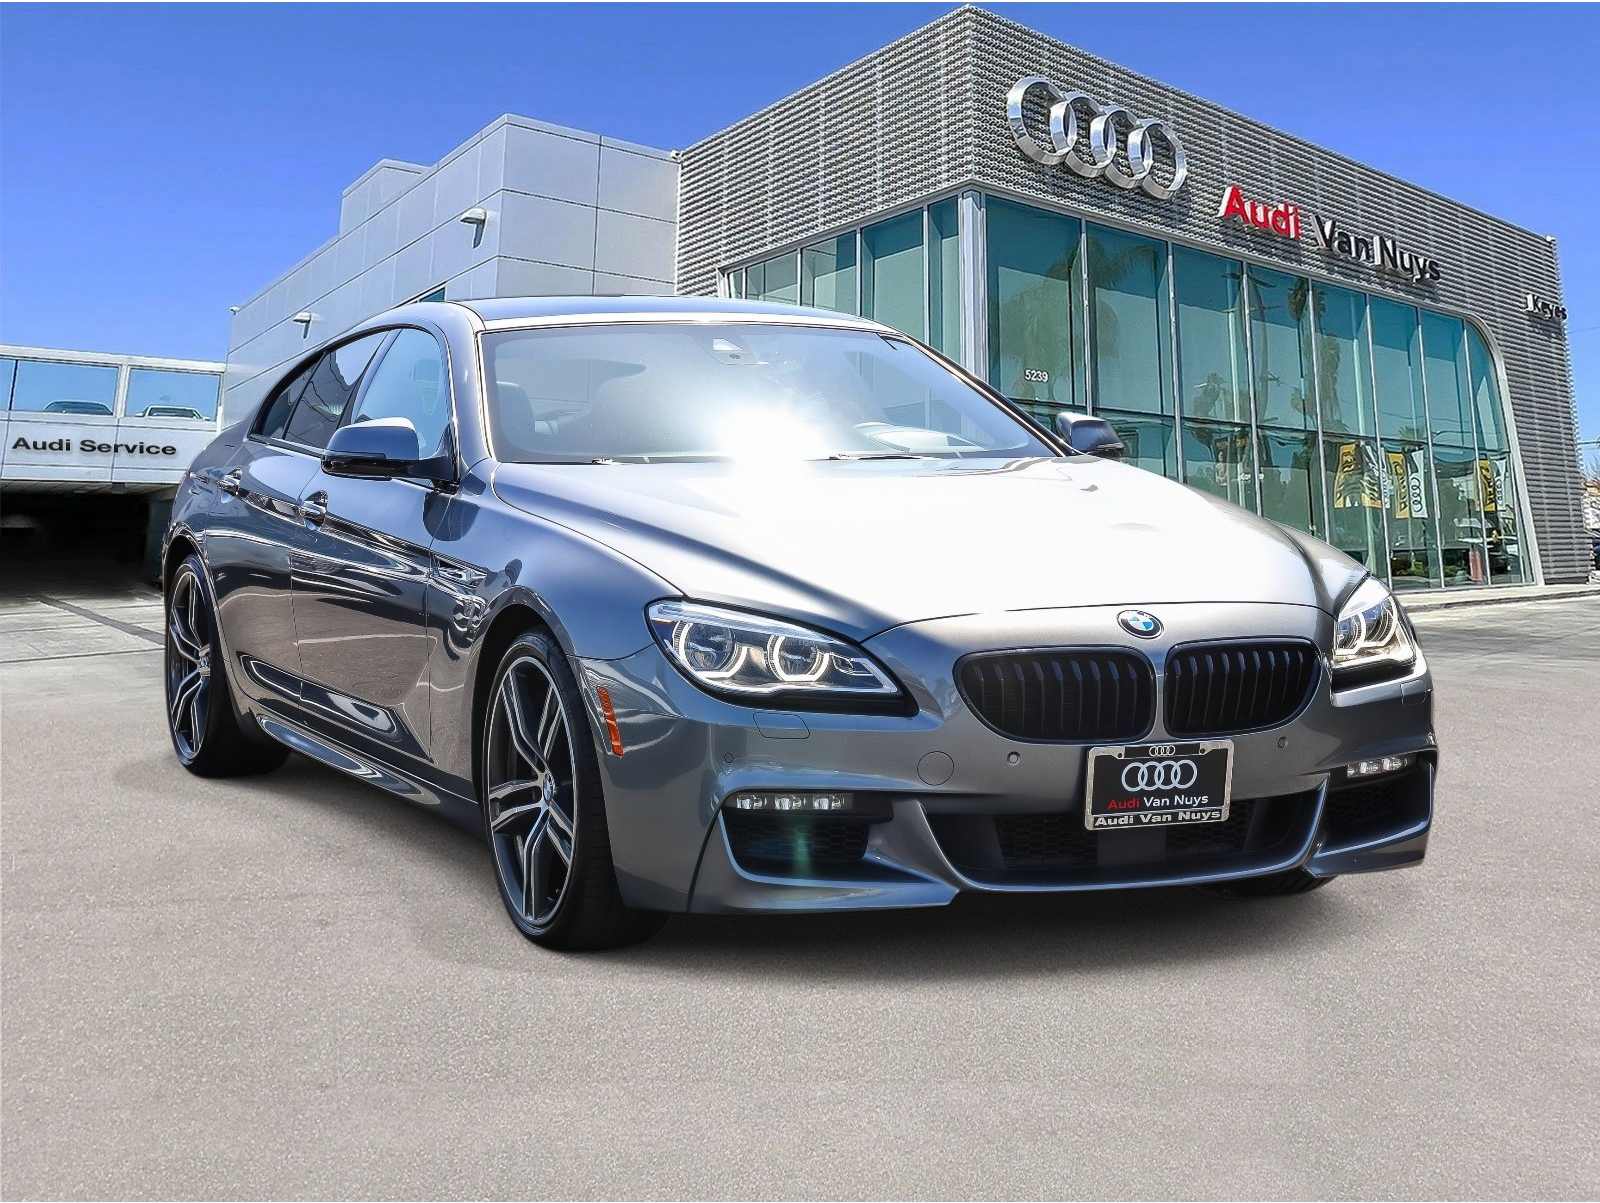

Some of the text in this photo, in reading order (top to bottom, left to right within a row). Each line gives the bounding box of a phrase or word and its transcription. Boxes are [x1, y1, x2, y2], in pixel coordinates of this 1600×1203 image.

[1218, 185, 1441, 282] Audi Van Nuys
[1025, 370, 1048, 382] 5239
[12, 437, 177, 455] Audi Service
[1107, 794, 1209, 810] Audi Van Nuys
[1094, 810, 1221, 826] Audi Van Nuys
